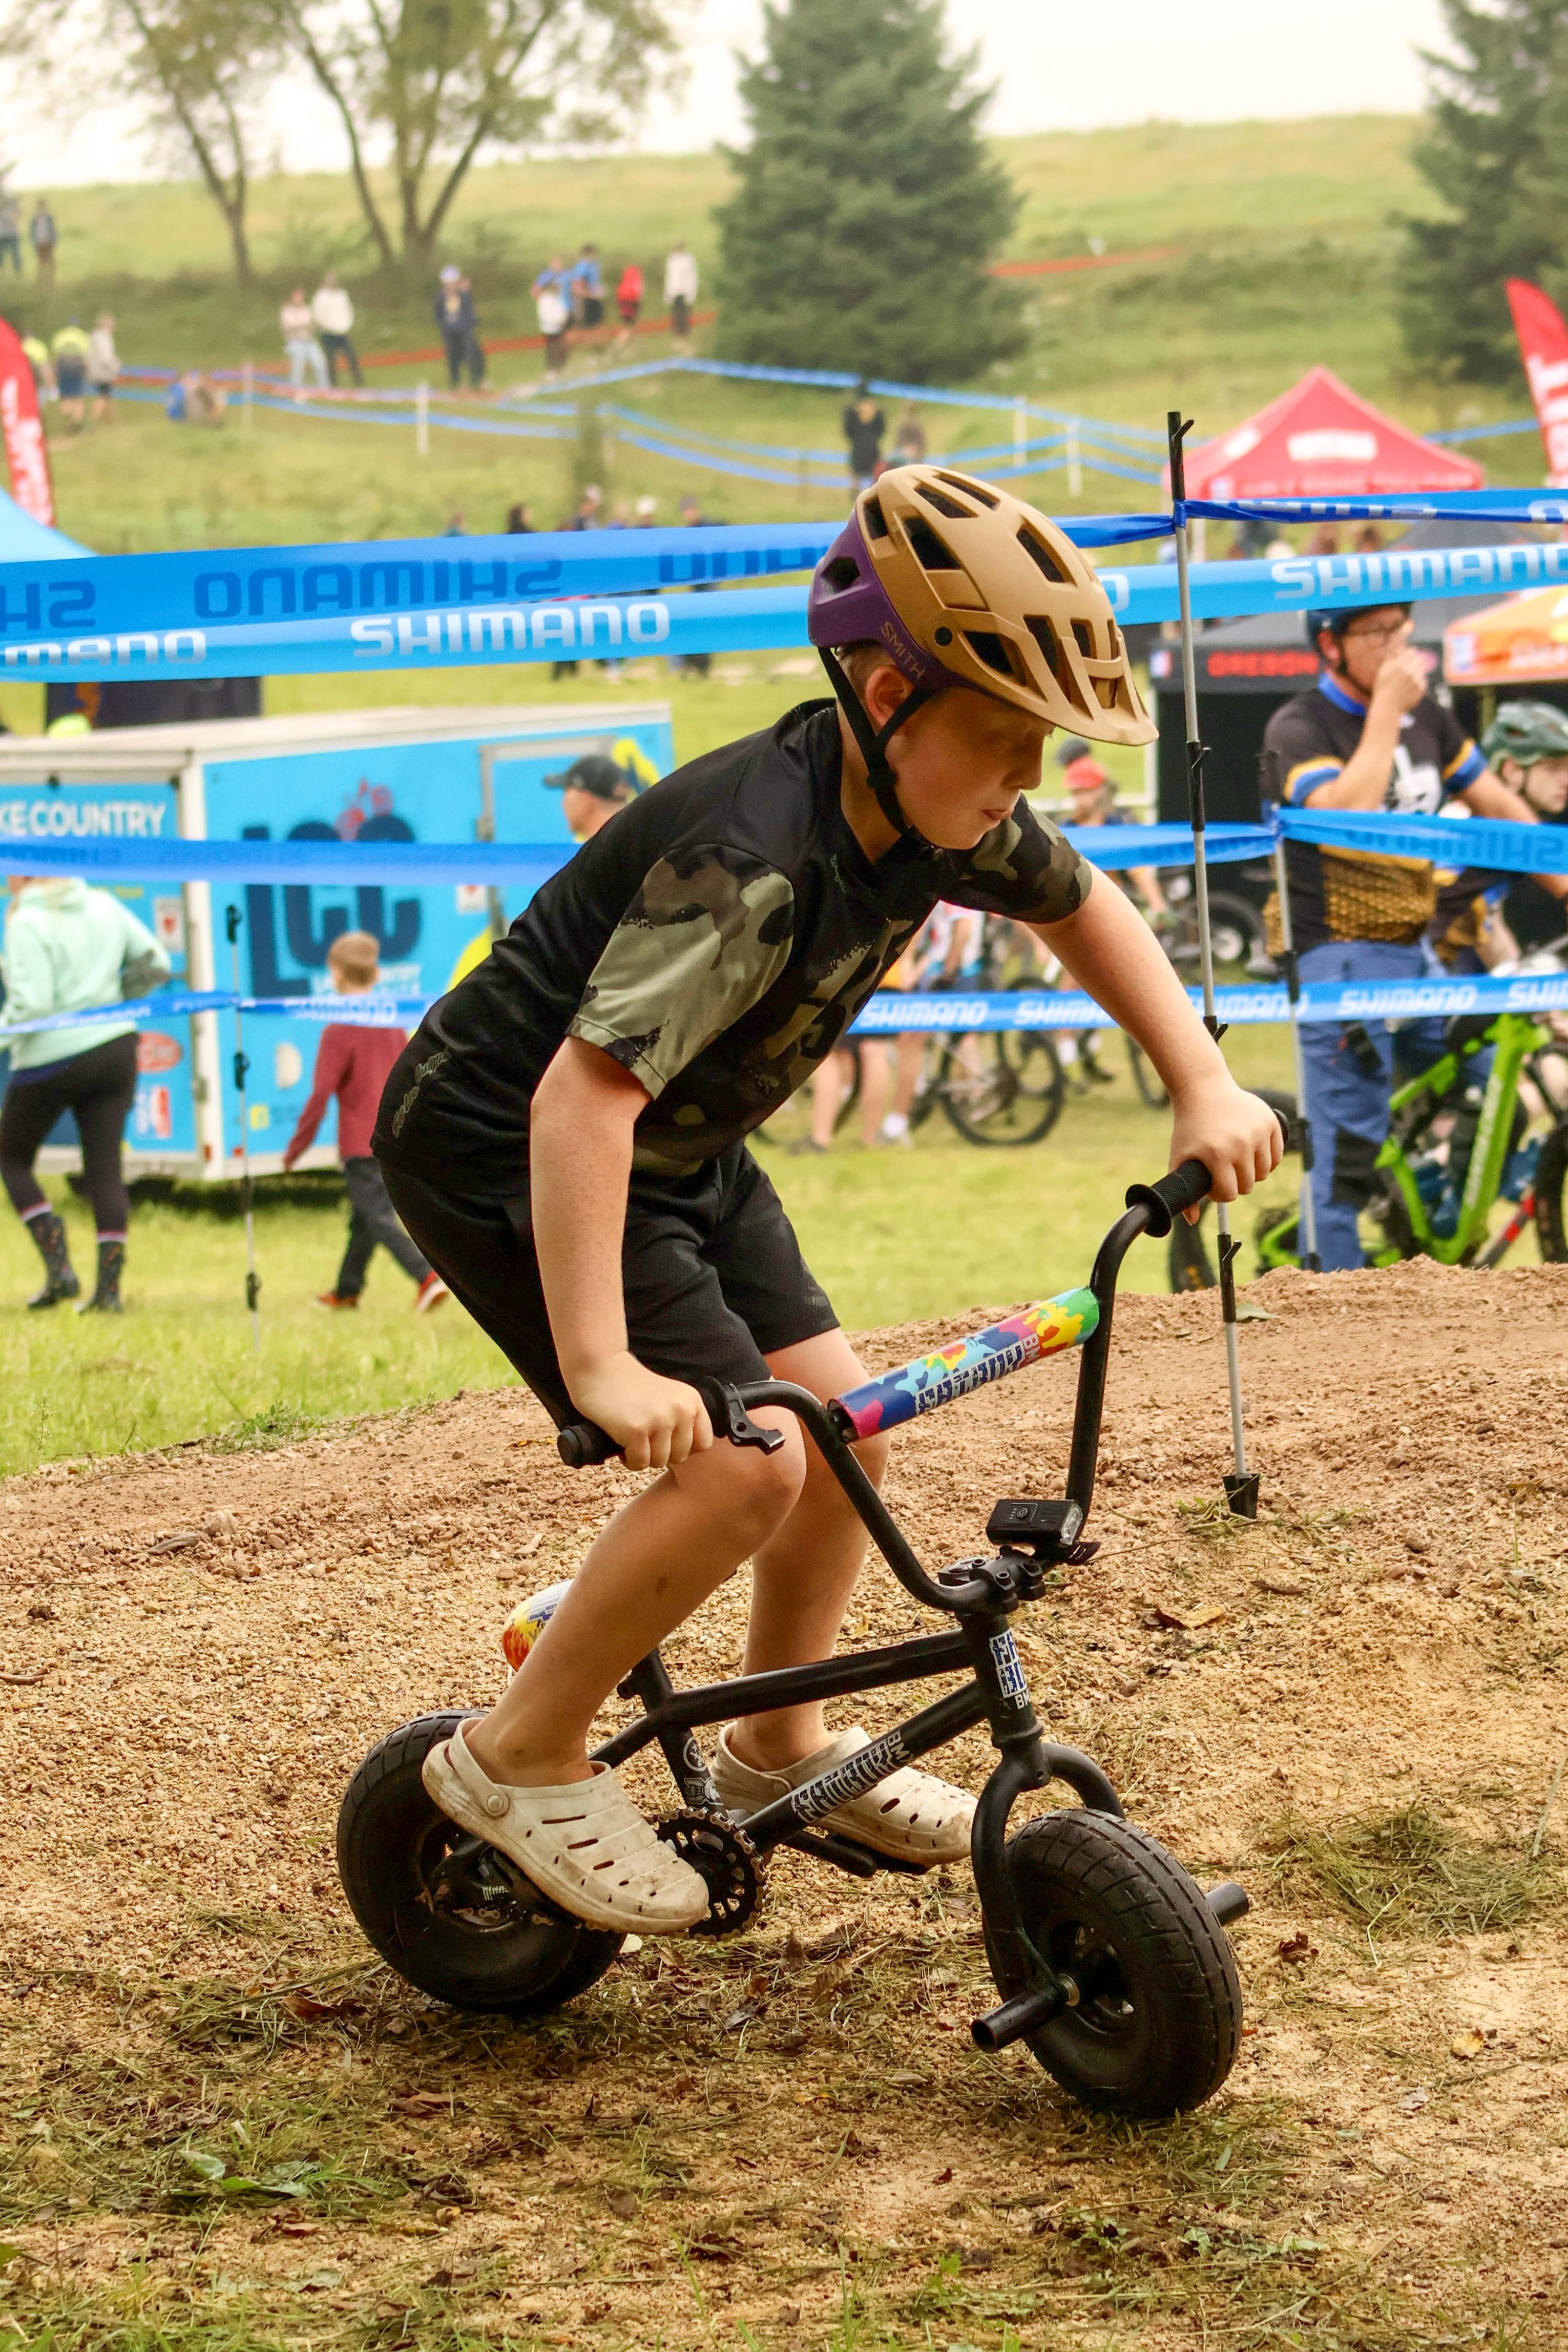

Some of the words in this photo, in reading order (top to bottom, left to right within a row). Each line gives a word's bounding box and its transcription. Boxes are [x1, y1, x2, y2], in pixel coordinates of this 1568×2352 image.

[350, 602, 670, 657] SHIMANO
[881, 621, 926, 681] SMITH
[30, 801, 165, 837] COUNTRY
[861, 1001, 989, 1027] SHIMANO
[1336, 985, 1478, 1016] SHIMANO
